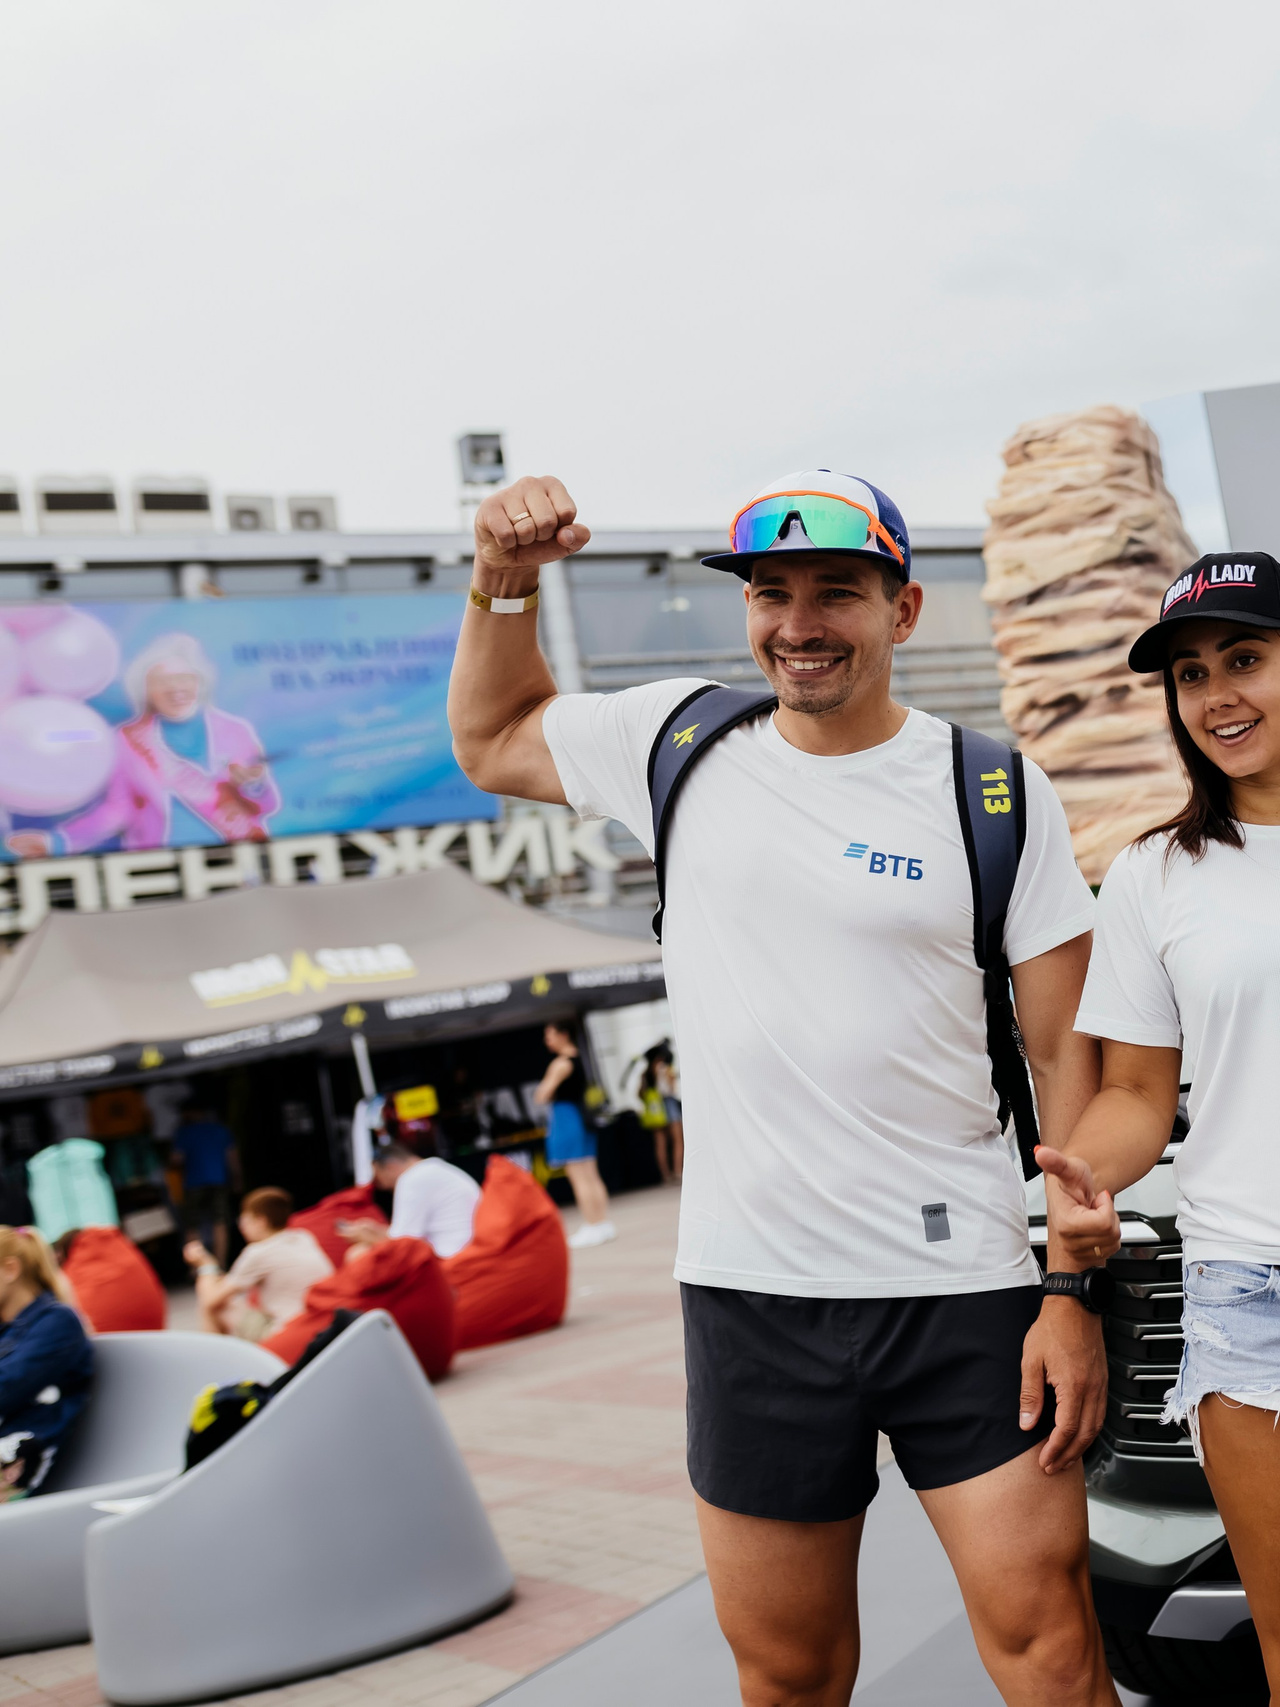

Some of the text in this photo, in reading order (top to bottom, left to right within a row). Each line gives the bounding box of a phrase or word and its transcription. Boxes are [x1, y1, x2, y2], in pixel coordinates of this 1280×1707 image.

[1163, 564, 1256, 610] IRON LADY
[980, 767, 1012, 815] 113
[868, 851, 924, 881] ВТБ
